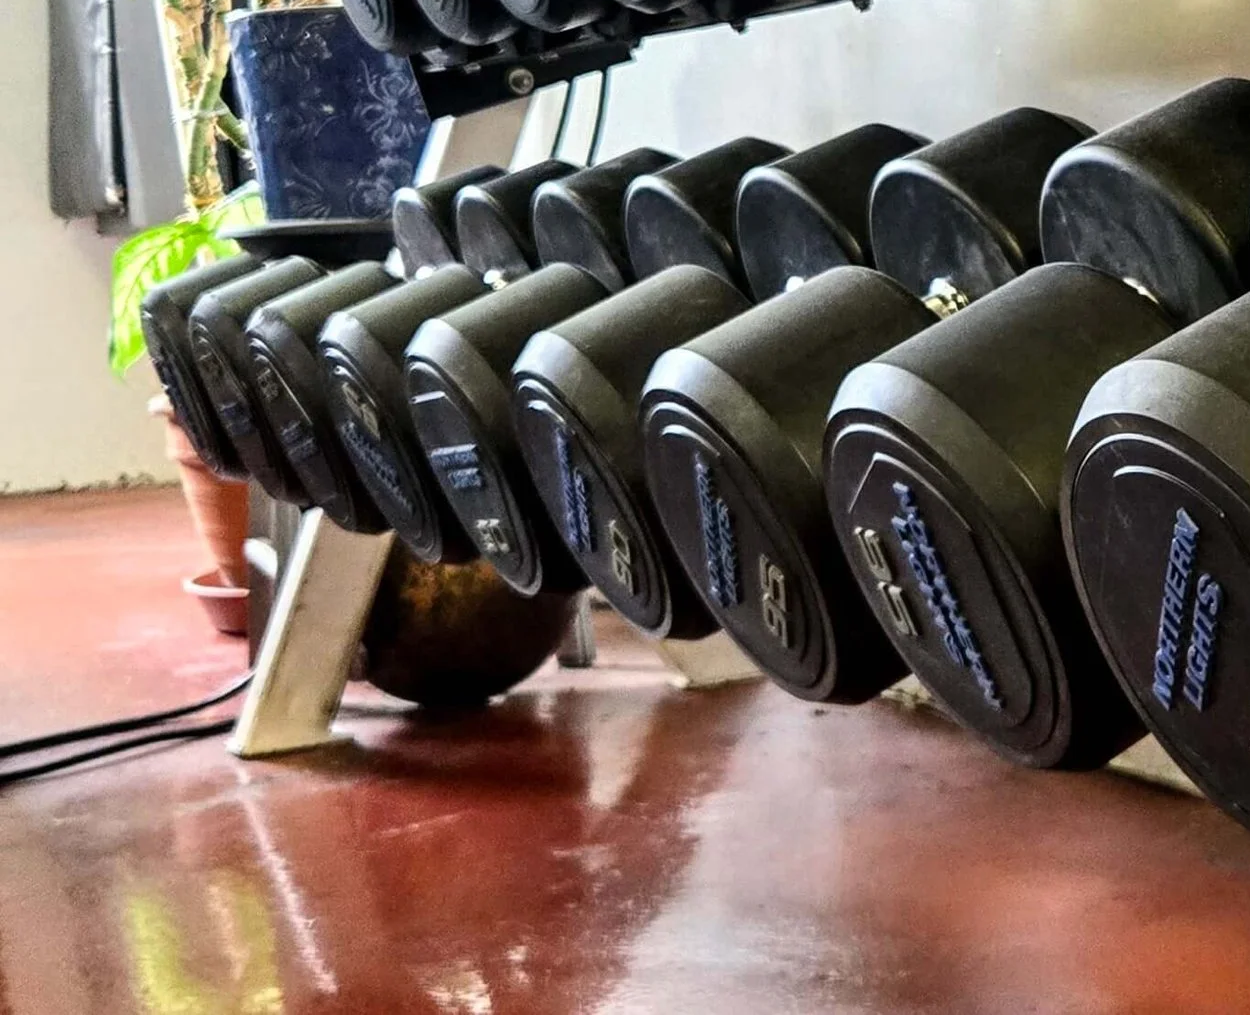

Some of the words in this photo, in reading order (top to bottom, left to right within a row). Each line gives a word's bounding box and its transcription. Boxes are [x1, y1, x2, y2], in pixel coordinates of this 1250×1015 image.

[759, 553, 788, 649] 95
[854, 526, 918, 636] 95
[890, 515, 964, 668] LIGHTS
[892, 481, 1002, 713] NORTHERN
[1152, 507, 1200, 712] NORTHERN
[1182, 573, 1222, 712] LIGHTS
